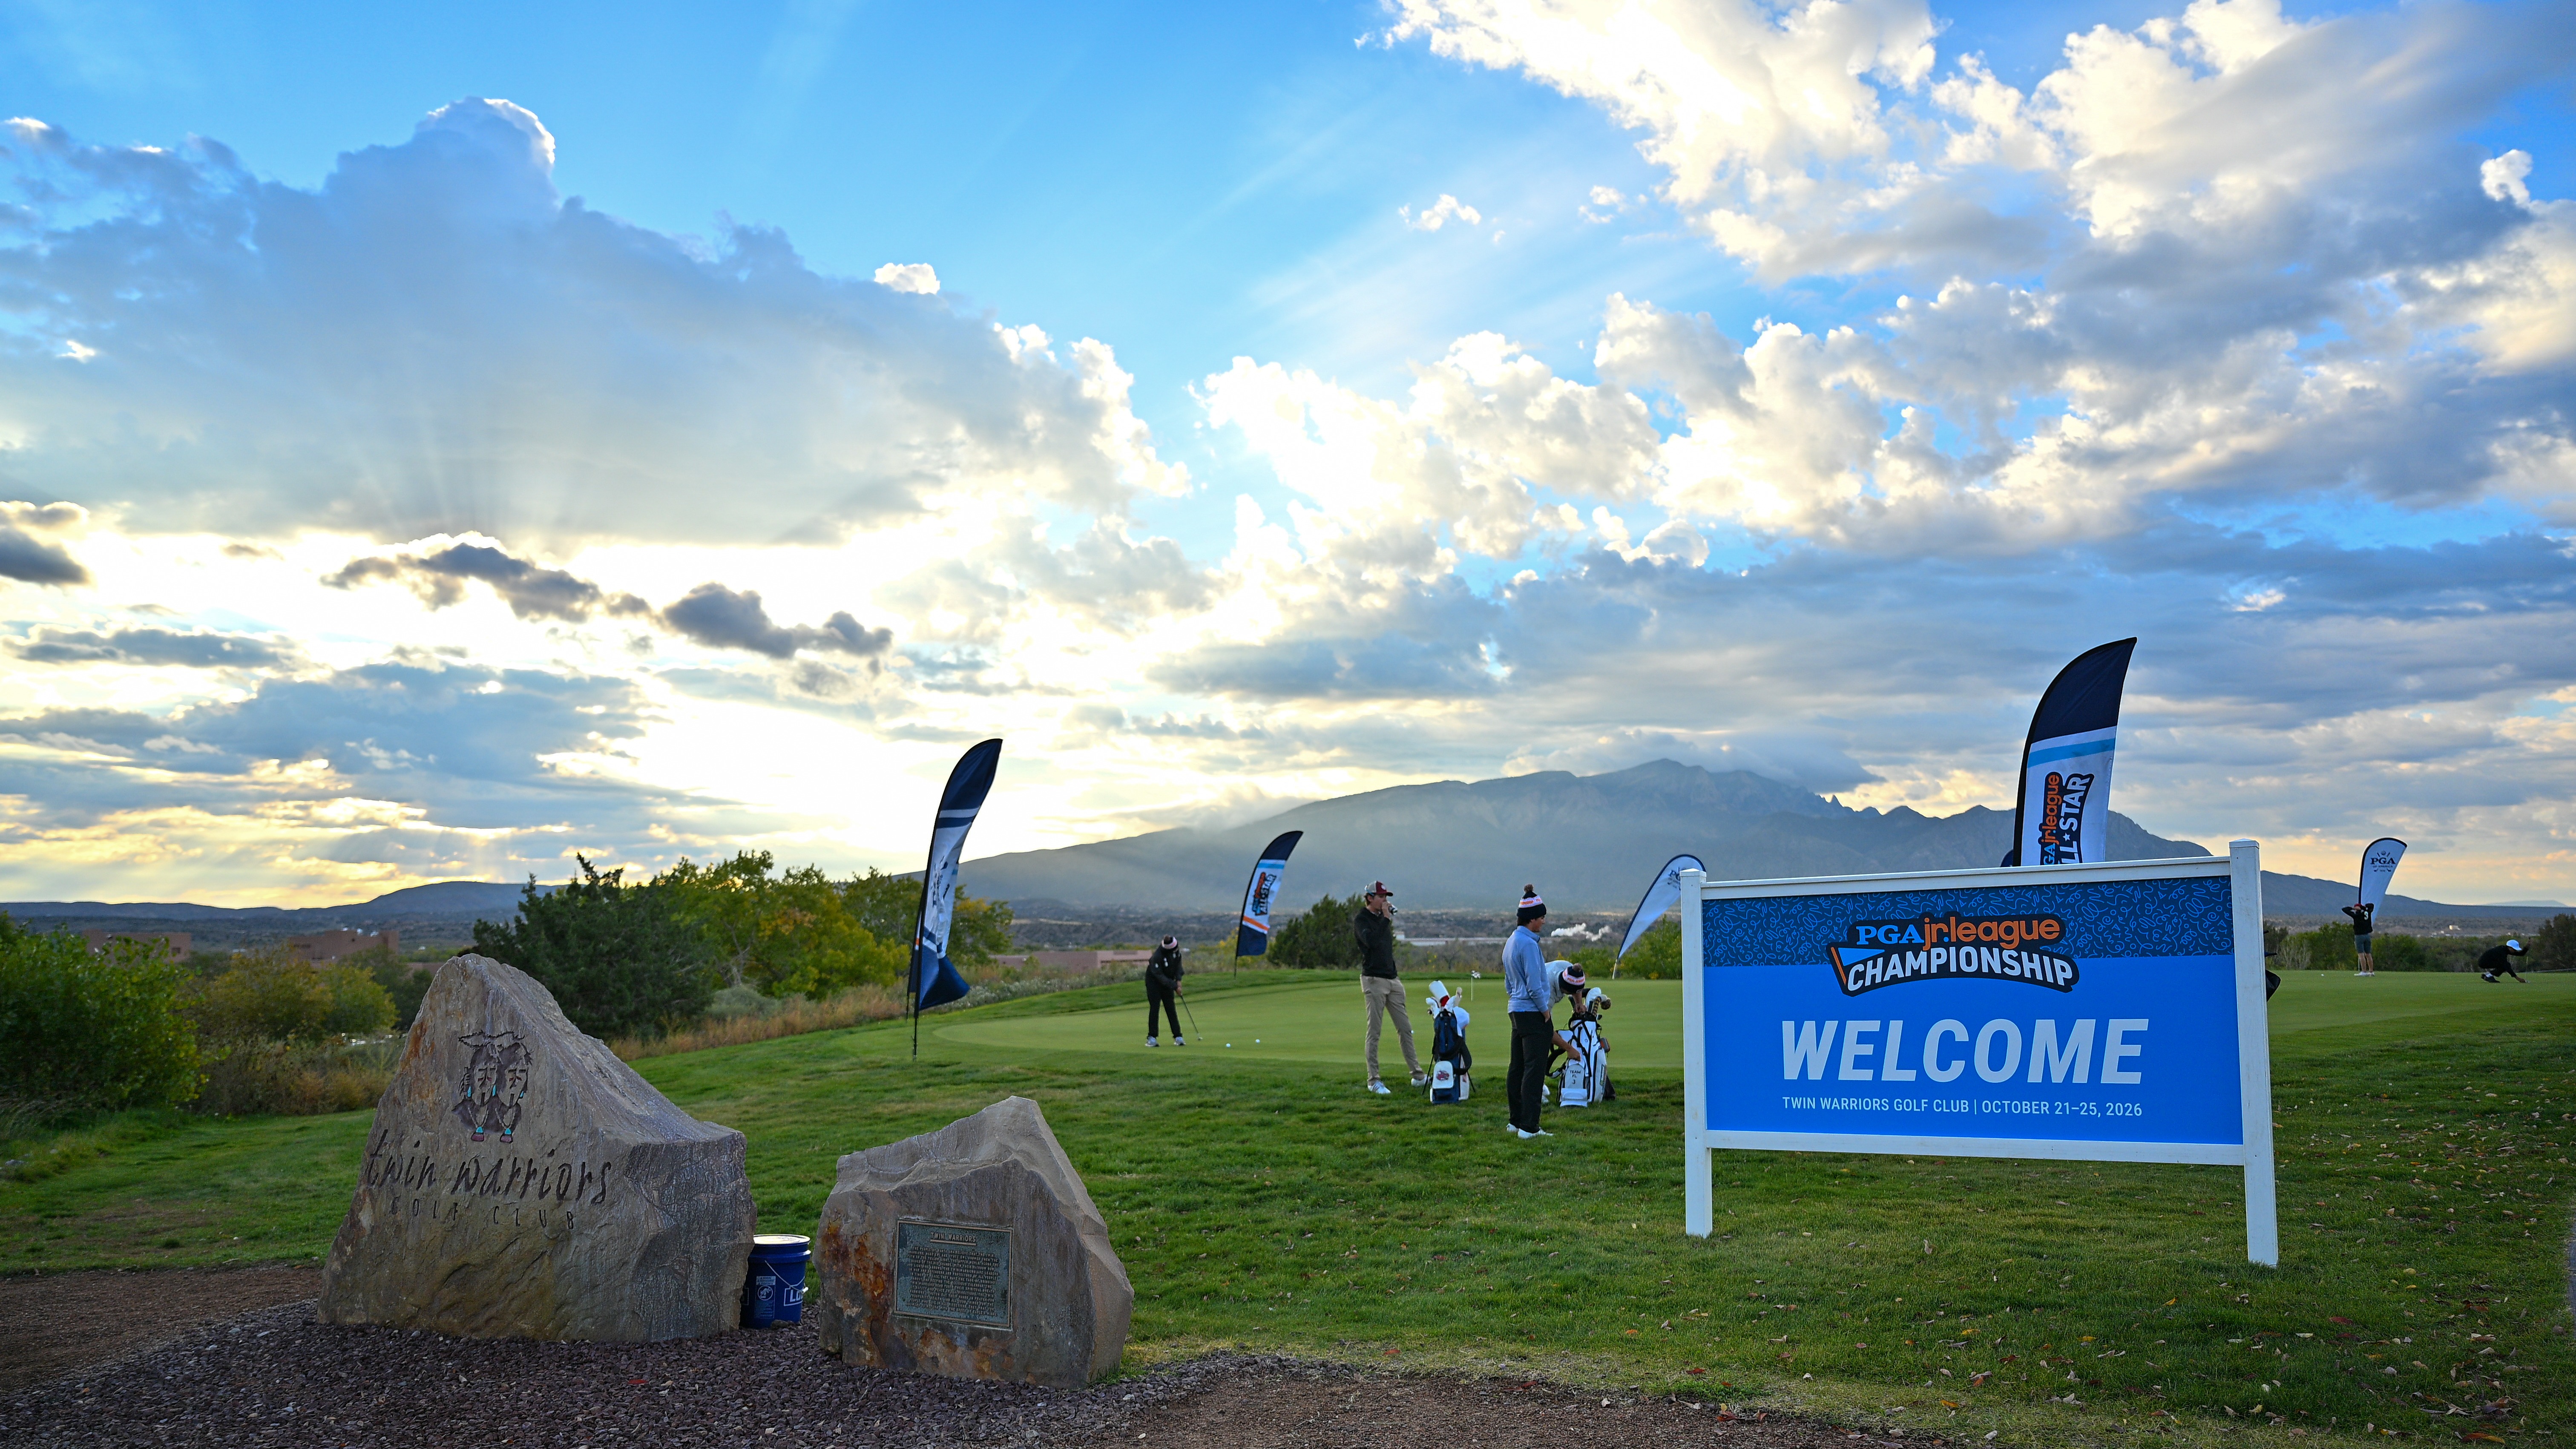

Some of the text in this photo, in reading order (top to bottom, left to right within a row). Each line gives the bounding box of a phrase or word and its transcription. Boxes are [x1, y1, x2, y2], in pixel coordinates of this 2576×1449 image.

[2058, 777, 2090, 865] LL STAR
[2044, 843, 2055, 865] GA
[1856, 924, 1924, 945] PGA
[1847, 946, 2073, 992] CHAMPIONSHIP
[1782, 1018, 2149, 1084] WELCOME
[1782, 1097, 1816, 1109] TWIN
[1820, 1097, 1889, 1110] WARRIORS
[1894, 1099, 1929, 1112] GOLF
[1933, 1099, 1969, 1113] CLUB
[1982, 1100, 2050, 1114] OCTOBER
[2105, 1103, 2143, 1116] 2026
[367, 1129, 612, 1205] twin warriors
[391, 1196, 574, 1230] GOLF CLUB
[948, 1233, 976, 1242] WARRIORS
